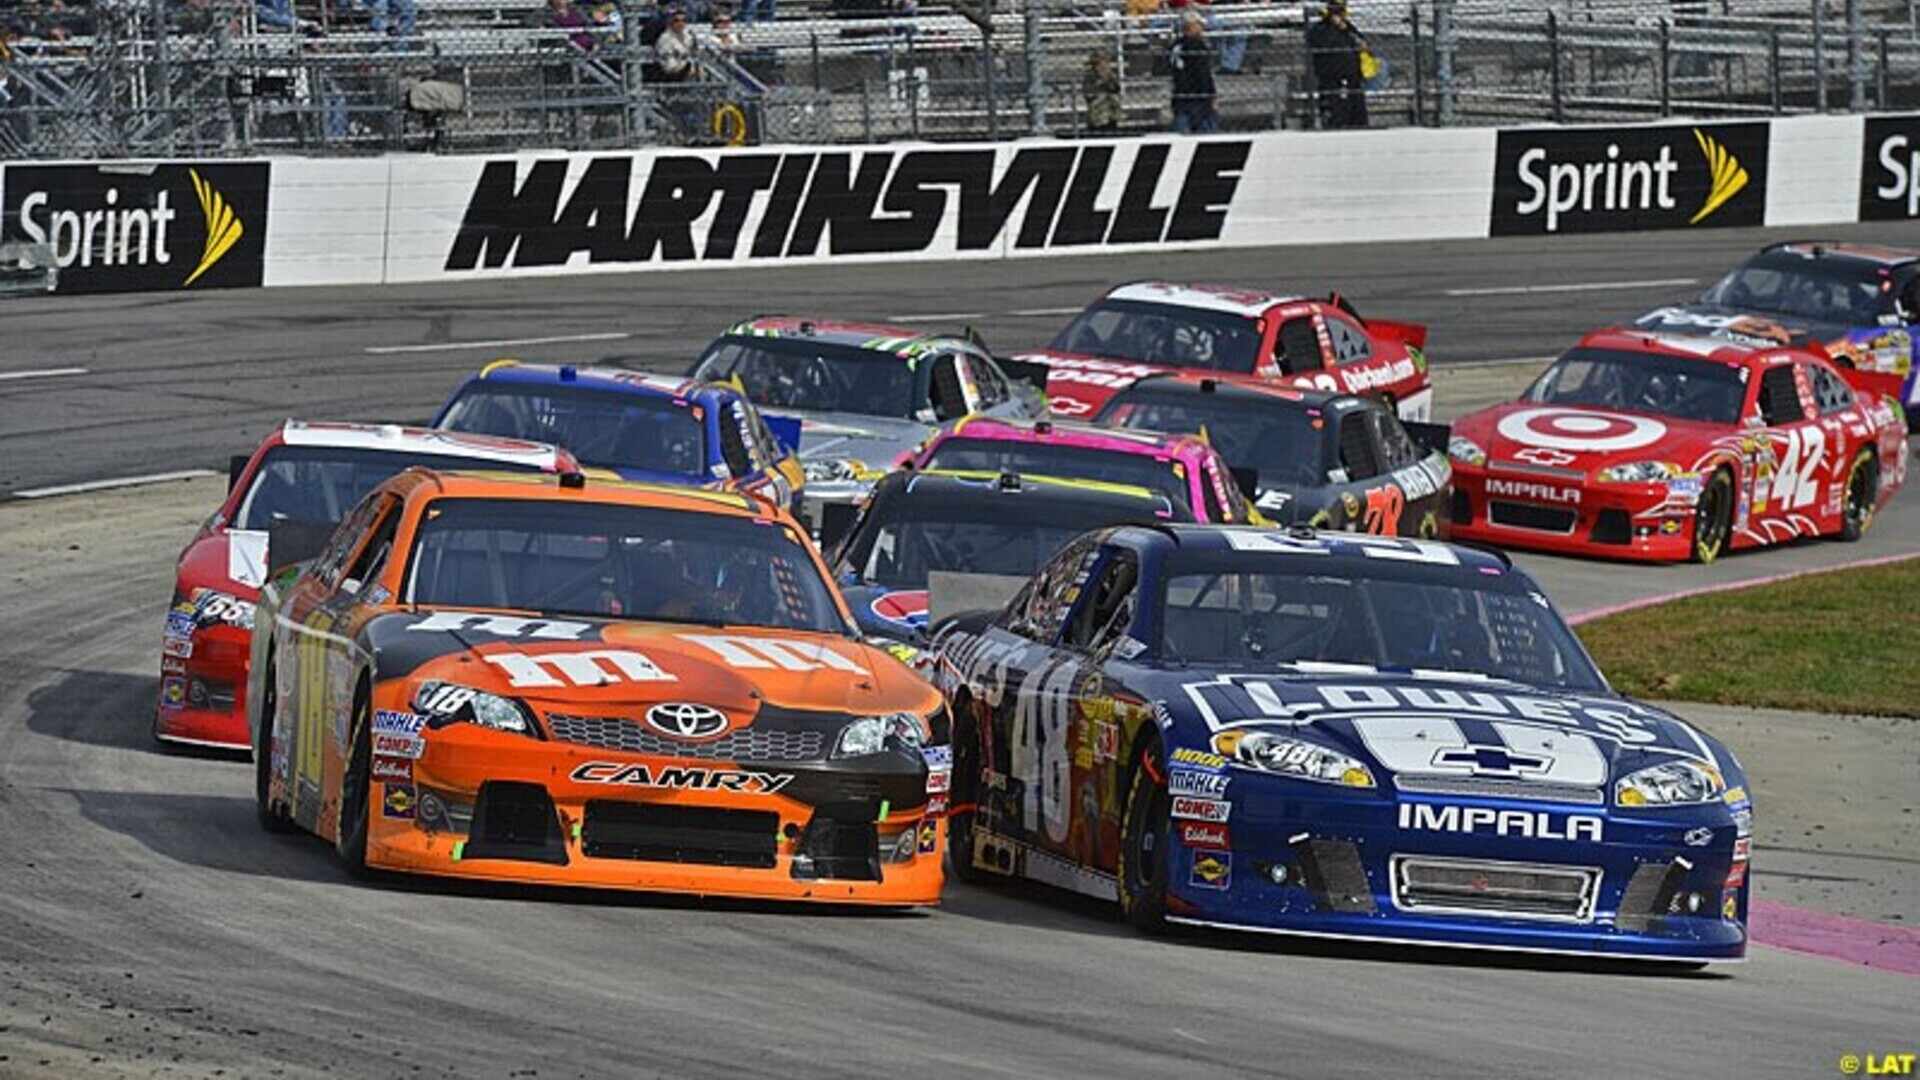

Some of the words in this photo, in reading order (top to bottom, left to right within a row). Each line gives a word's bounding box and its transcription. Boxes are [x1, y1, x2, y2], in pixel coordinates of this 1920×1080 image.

[444, 140, 1253, 271] MARTINSVILLE
[1517, 145, 1678, 232] Sprint
[20, 188, 175, 291] Sprint
[1486, 479, 1582, 503] IMPALA
[1772, 426, 1826, 510] 42
[424, 685, 477, 713] 18
[481, 650, 681, 687] m
[1242, 681, 1658, 742] LOWE'S
[569, 762, 796, 795] CAMRY
[1010, 655, 1080, 844] 48
[1398, 802, 1603, 842] IMPALA
